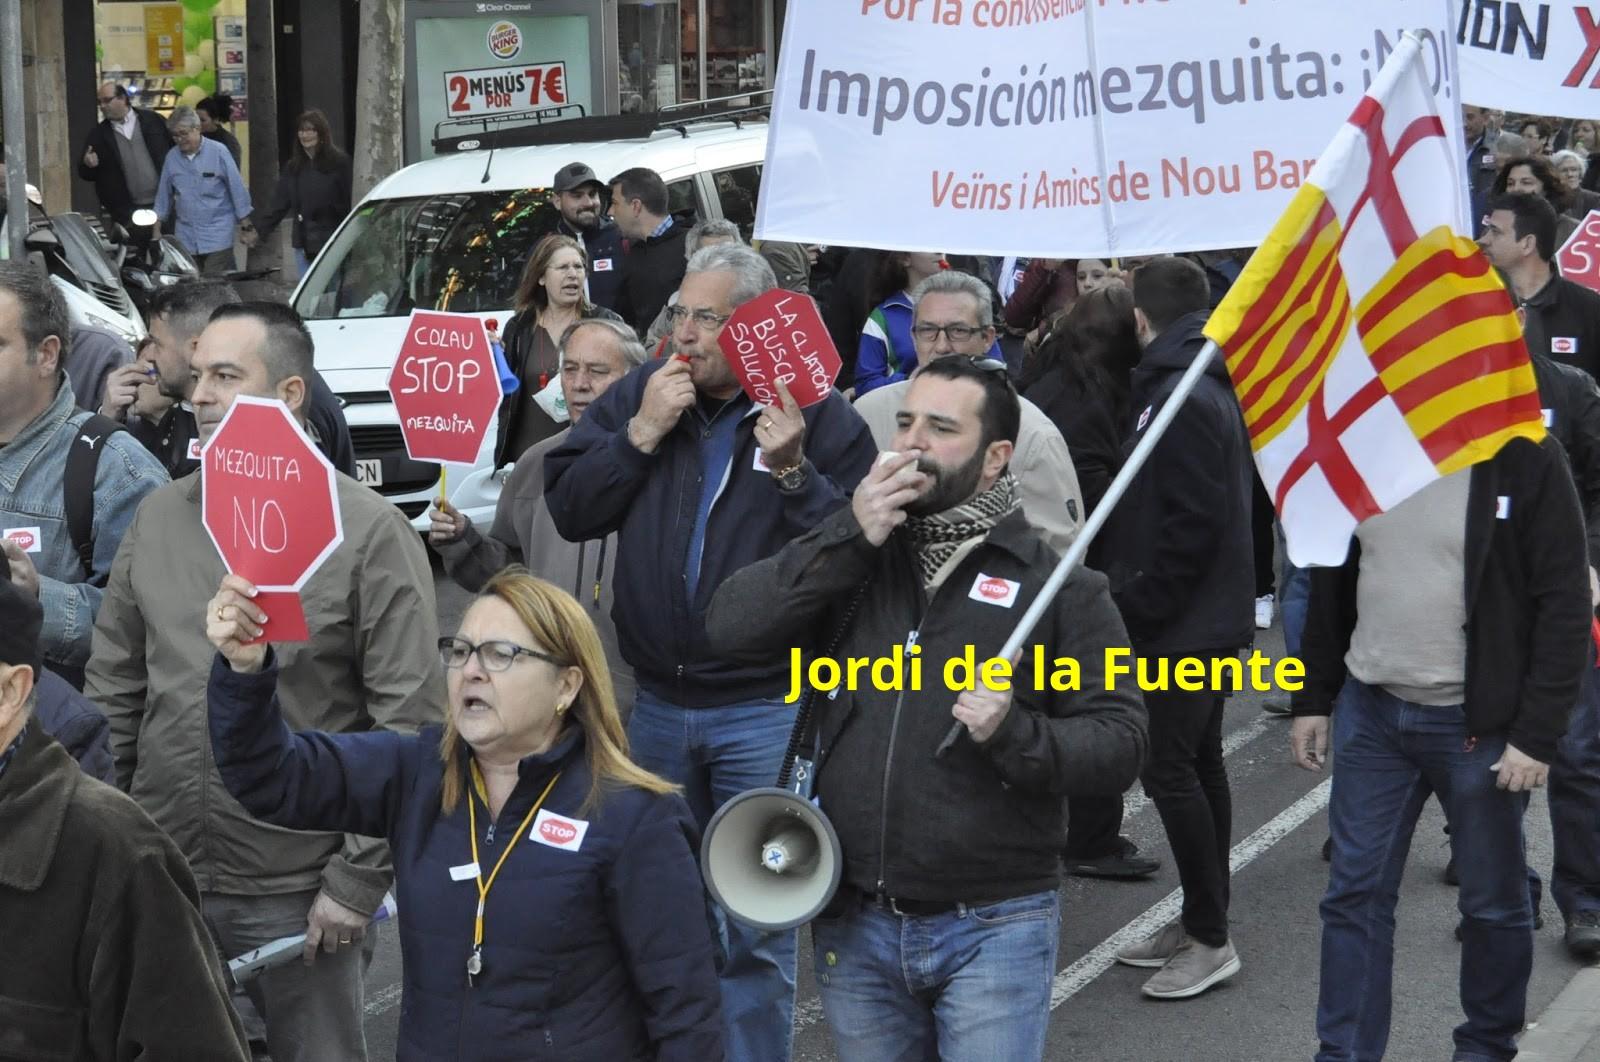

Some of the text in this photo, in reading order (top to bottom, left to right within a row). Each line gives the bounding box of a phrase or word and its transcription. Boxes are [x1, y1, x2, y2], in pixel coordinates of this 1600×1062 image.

[486, 4, 503, 12] Clear
[491, 28, 517, 42] BURGER
[493, 35, 519, 51] KING
[449, 66, 565, 112] 2 MENÚS 7€
[485, 93, 512, 109] POR
[799, 49, 1066, 136] Imposición
[1073, 37, 1345, 124] mezquita:
[932, 170, 1012, 211] Veïns
[1019, 172, 1028, 210] i
[1032, 167, 1101, 209] Amics
[1107, 160, 1150, 203] de
[1161, 156, 1241, 199] Nou
[774, 296, 798, 328] LA
[414, 326, 474, 351] COLAU
[752, 318, 796, 386] BUSCA
[401, 356, 481, 394] STOP
[214, 445, 302, 483] MEZQUITA
[233, 495, 288, 554] NO
[981, 583, 1009, 595] STOP
[542, 823, 574, 838] STOP
